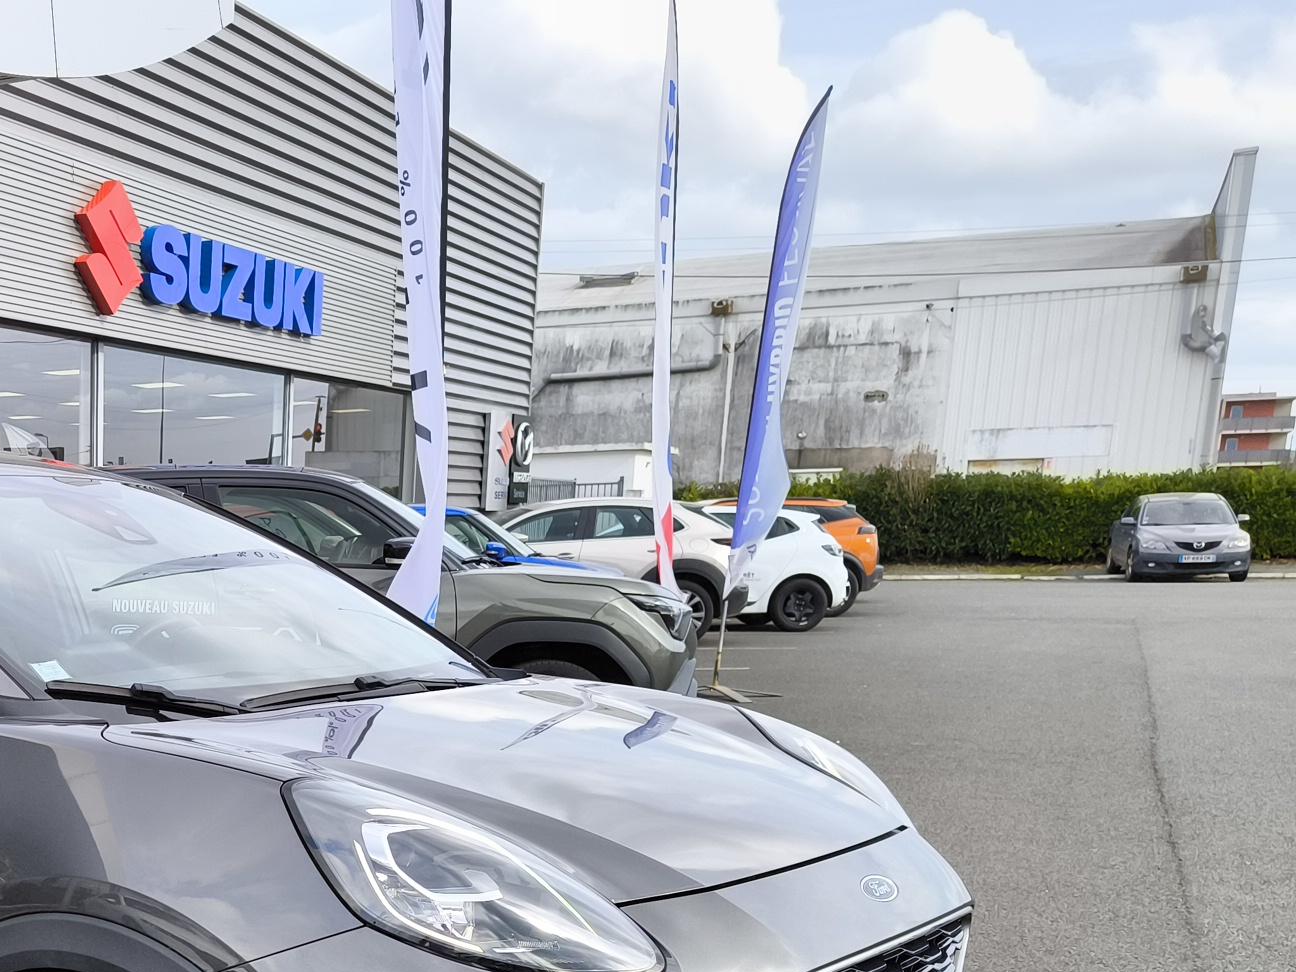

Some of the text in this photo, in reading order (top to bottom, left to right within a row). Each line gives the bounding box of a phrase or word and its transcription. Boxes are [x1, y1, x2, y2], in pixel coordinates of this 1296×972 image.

[142, 224, 324, 337] SUZUKI
[112, 599, 216, 615] NOUVEAU SUZUKI
